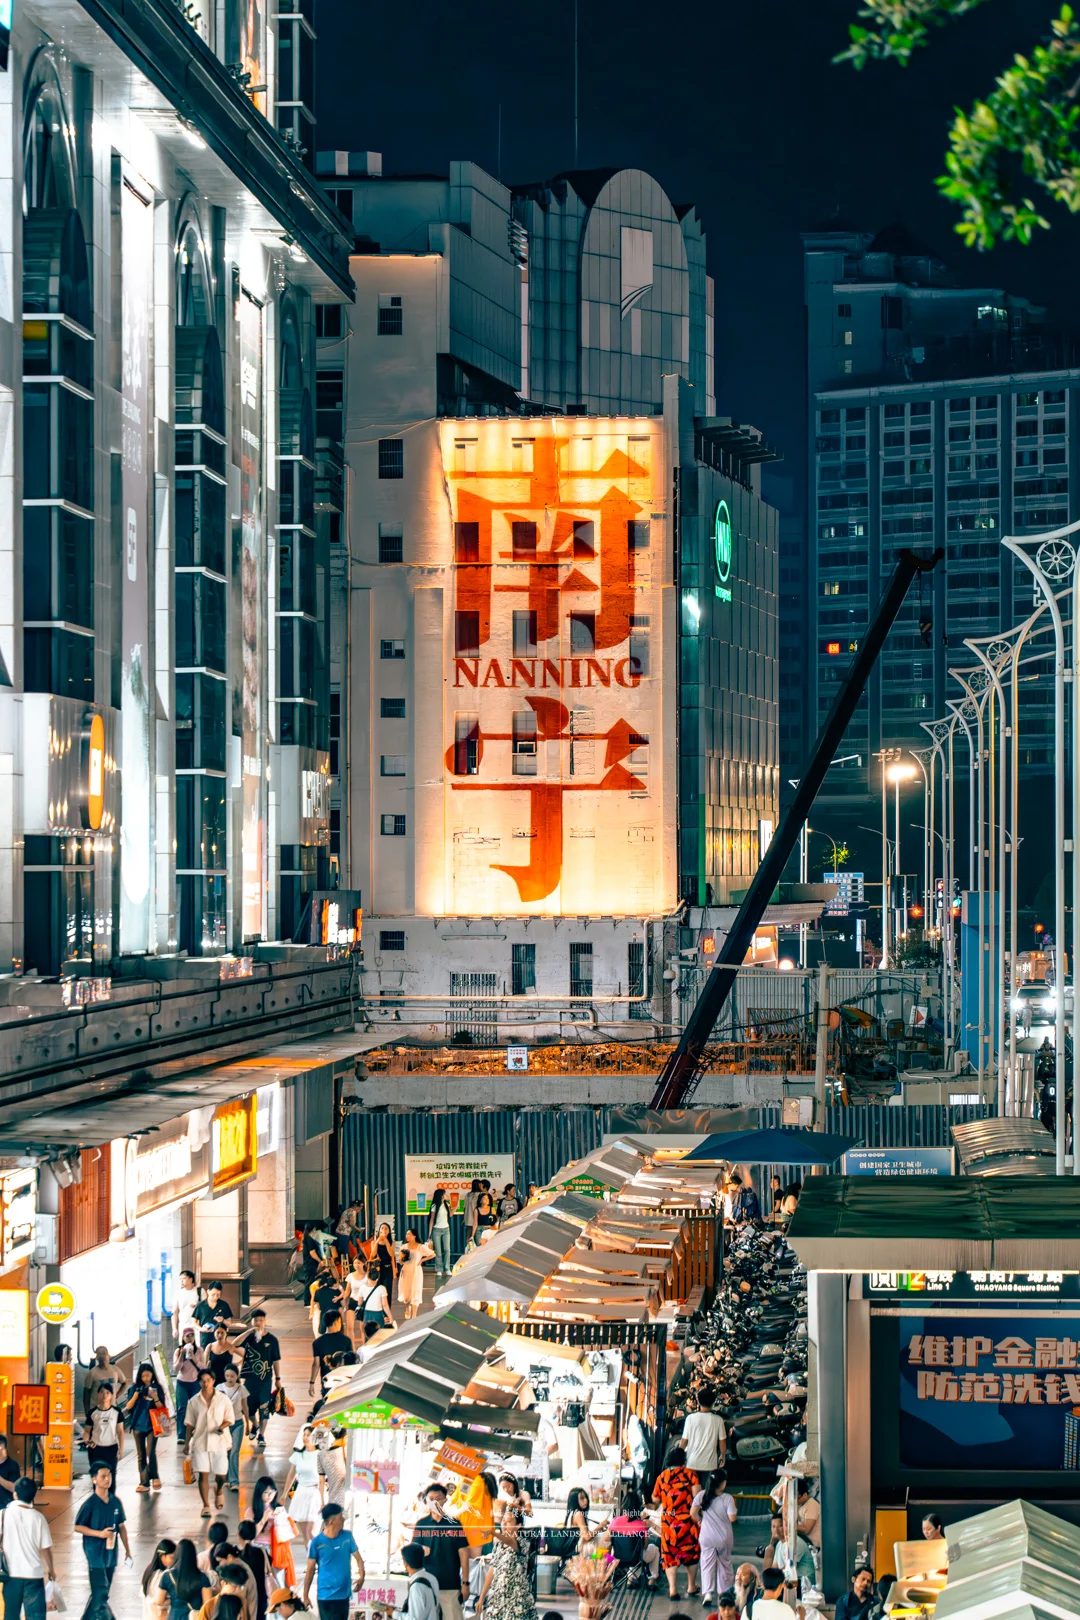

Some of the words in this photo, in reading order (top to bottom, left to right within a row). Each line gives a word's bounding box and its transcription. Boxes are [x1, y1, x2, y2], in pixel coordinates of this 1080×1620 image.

[445, 436, 650, 653] 南
[453, 658, 641, 689] NANNING
[445, 696, 650, 902] 宁
[420, 1171, 502, 1179] 共创卫生文明城市我先行
[436, 1162, 488, 1170] 垃圾分类我能行
[927, 1283, 944, 1291] Line
[1013, 1284, 1035, 1292] Square
[908, 1335, 1079, 1369] 维护金融
[917, 1370, 1080, 1404] 防范洗钱
[19, 1394, 44, 1424] 烟
[372, 1470, 382, 1492] 1
[386, 1483, 395, 1493] 元
[358, 1588, 396, 1605] 网红发夹
